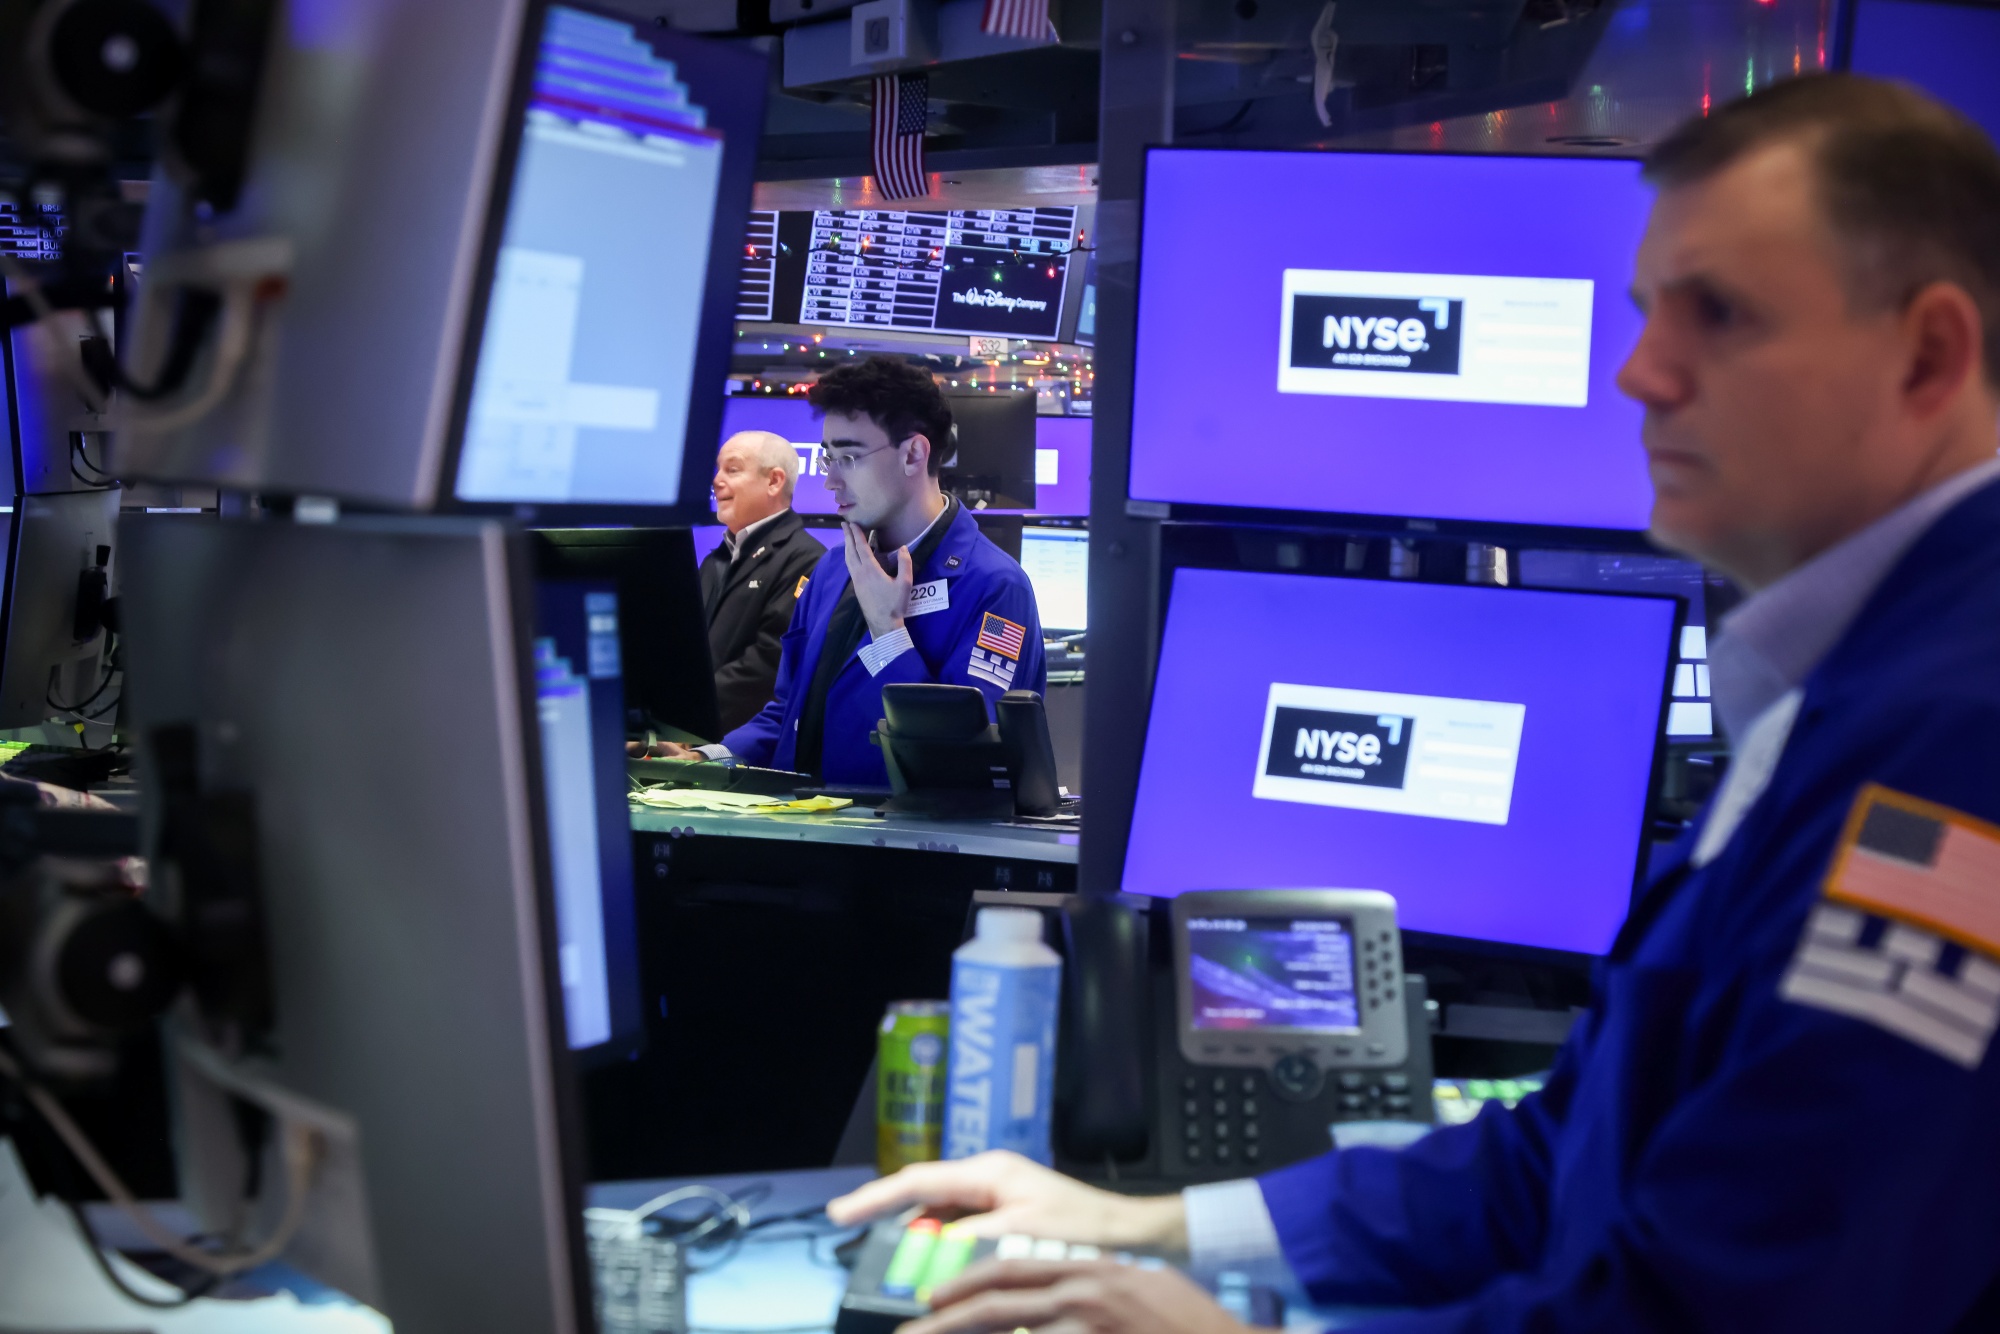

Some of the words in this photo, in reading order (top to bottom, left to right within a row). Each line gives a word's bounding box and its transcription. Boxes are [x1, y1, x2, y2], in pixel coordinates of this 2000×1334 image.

[953, 292, 965, 303] The
[1016, 297, 1047, 311] Company
[910, 585, 937, 601] 220
